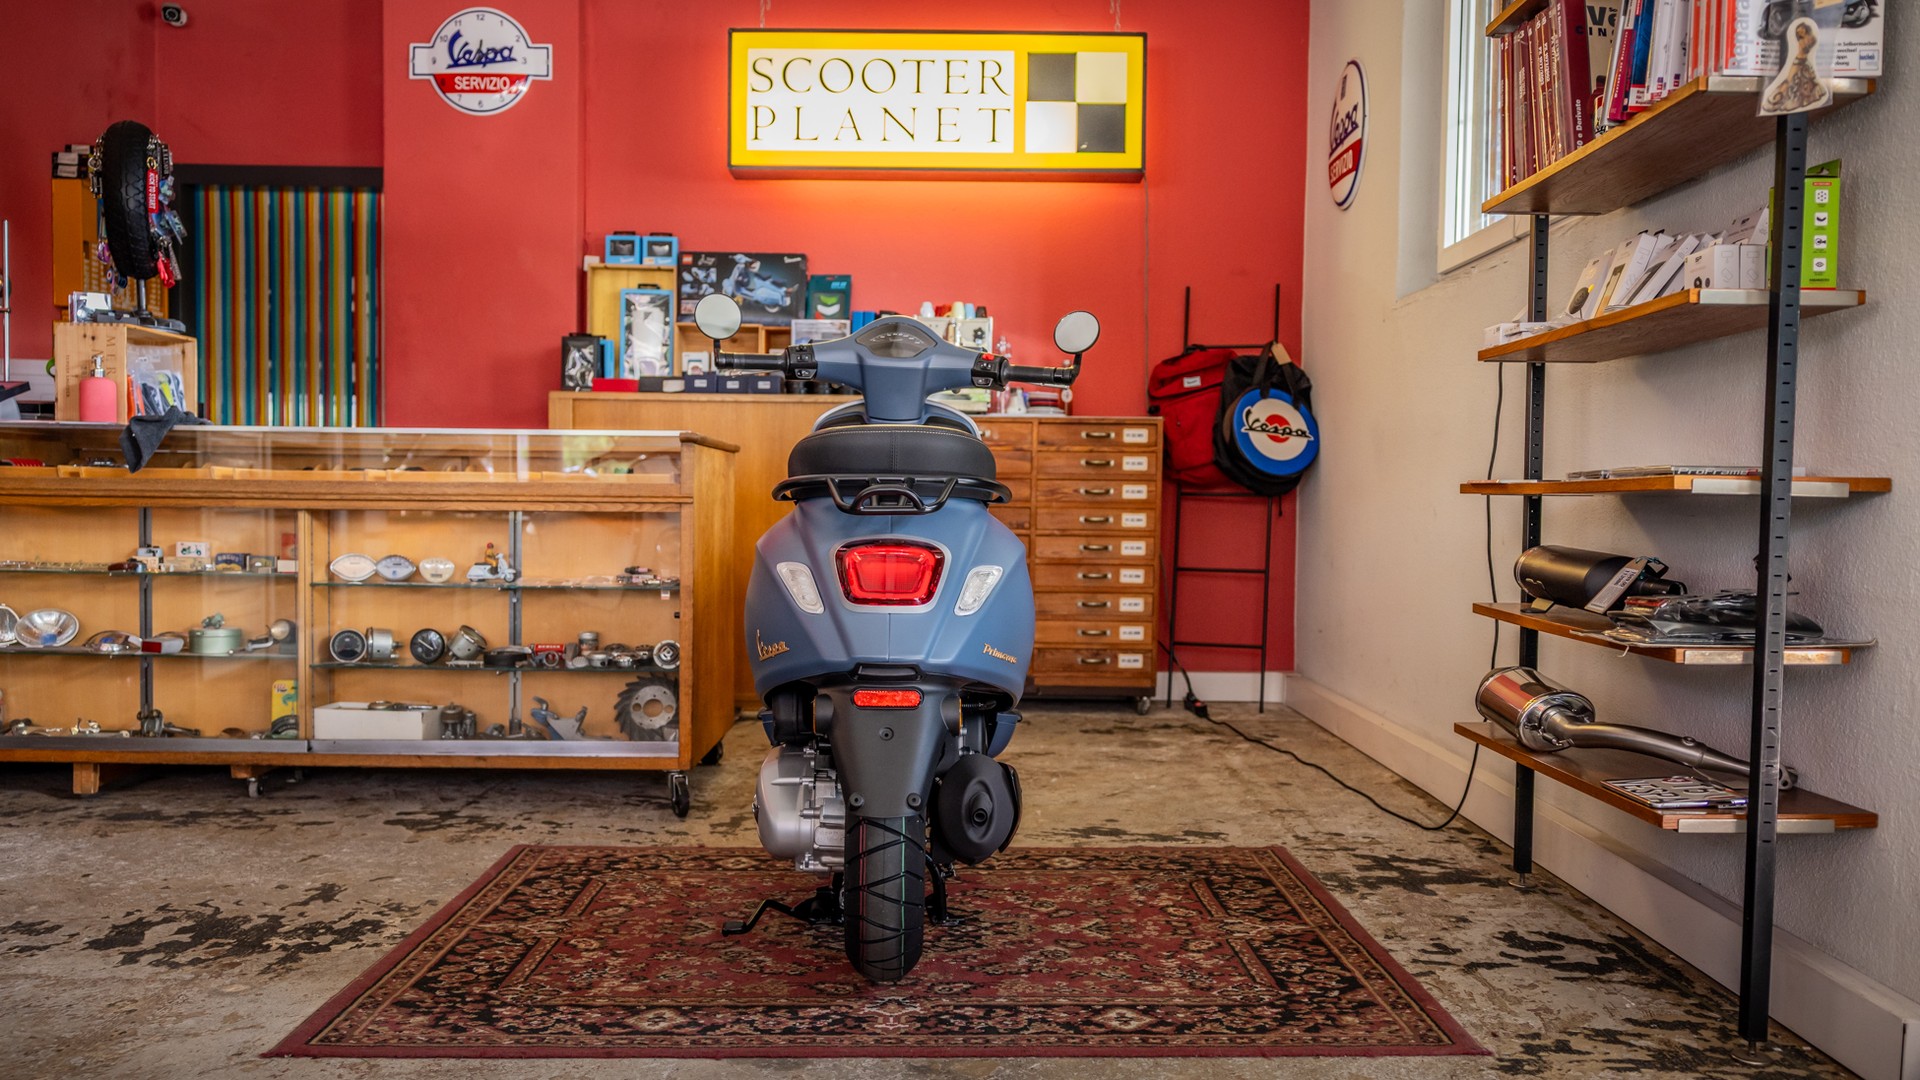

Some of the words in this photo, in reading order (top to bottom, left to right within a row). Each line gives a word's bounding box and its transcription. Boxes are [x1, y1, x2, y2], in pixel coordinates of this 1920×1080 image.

[446, 29, 517, 69] Vespa
[454, 76, 511, 91] SERVIZIO
[750, 56, 1012, 97] SCOOTER
[750, 105, 1011, 143] PLANET
[1575, 99, 1583, 131] Derivate
[1330, 149, 1353, 181] SERVIZIO
[1242, 406, 1313, 440] Vespa
[756, 628, 790, 662] Vespa
